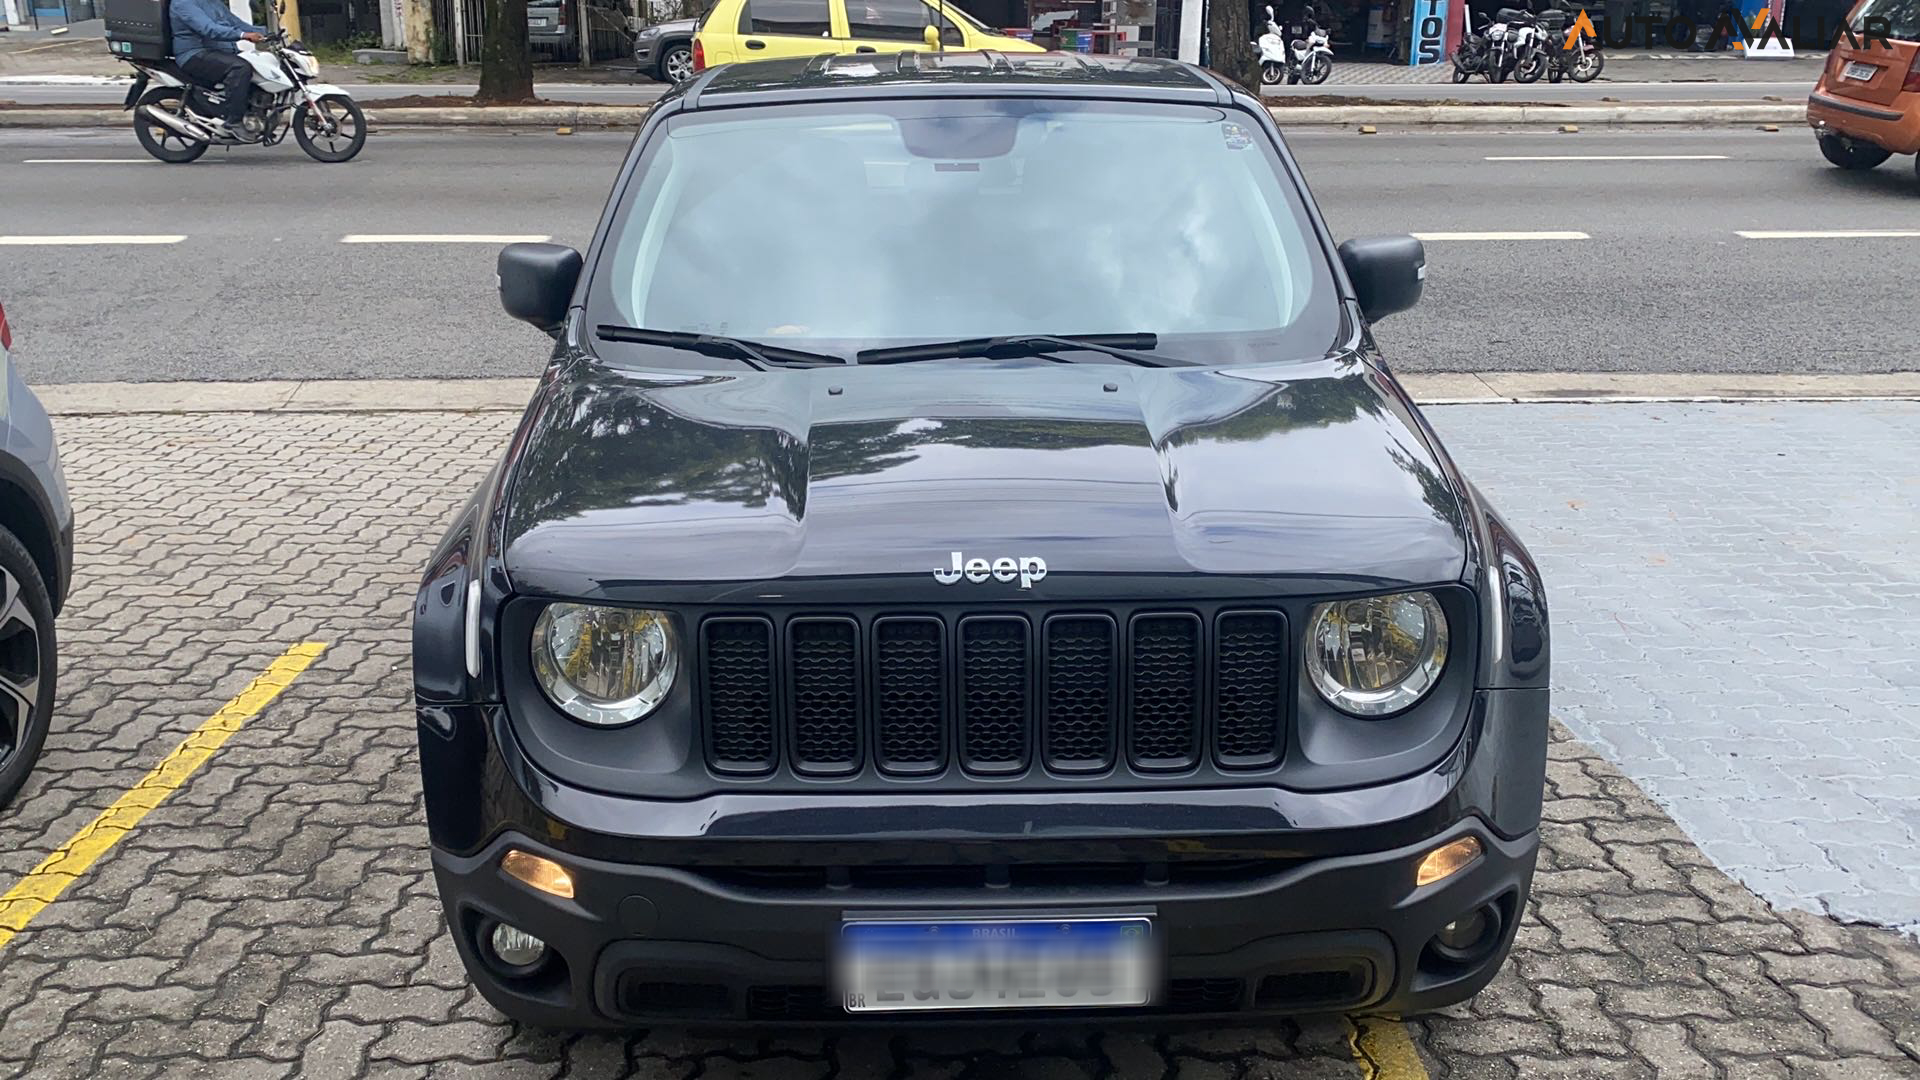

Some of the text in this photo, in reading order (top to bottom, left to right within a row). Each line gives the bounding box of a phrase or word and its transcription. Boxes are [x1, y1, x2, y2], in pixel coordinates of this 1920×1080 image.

[933, 552, 1048, 589] Jeep
[972, 928, 1018, 940] BRASIL
[849, 993, 866, 1008] BR
